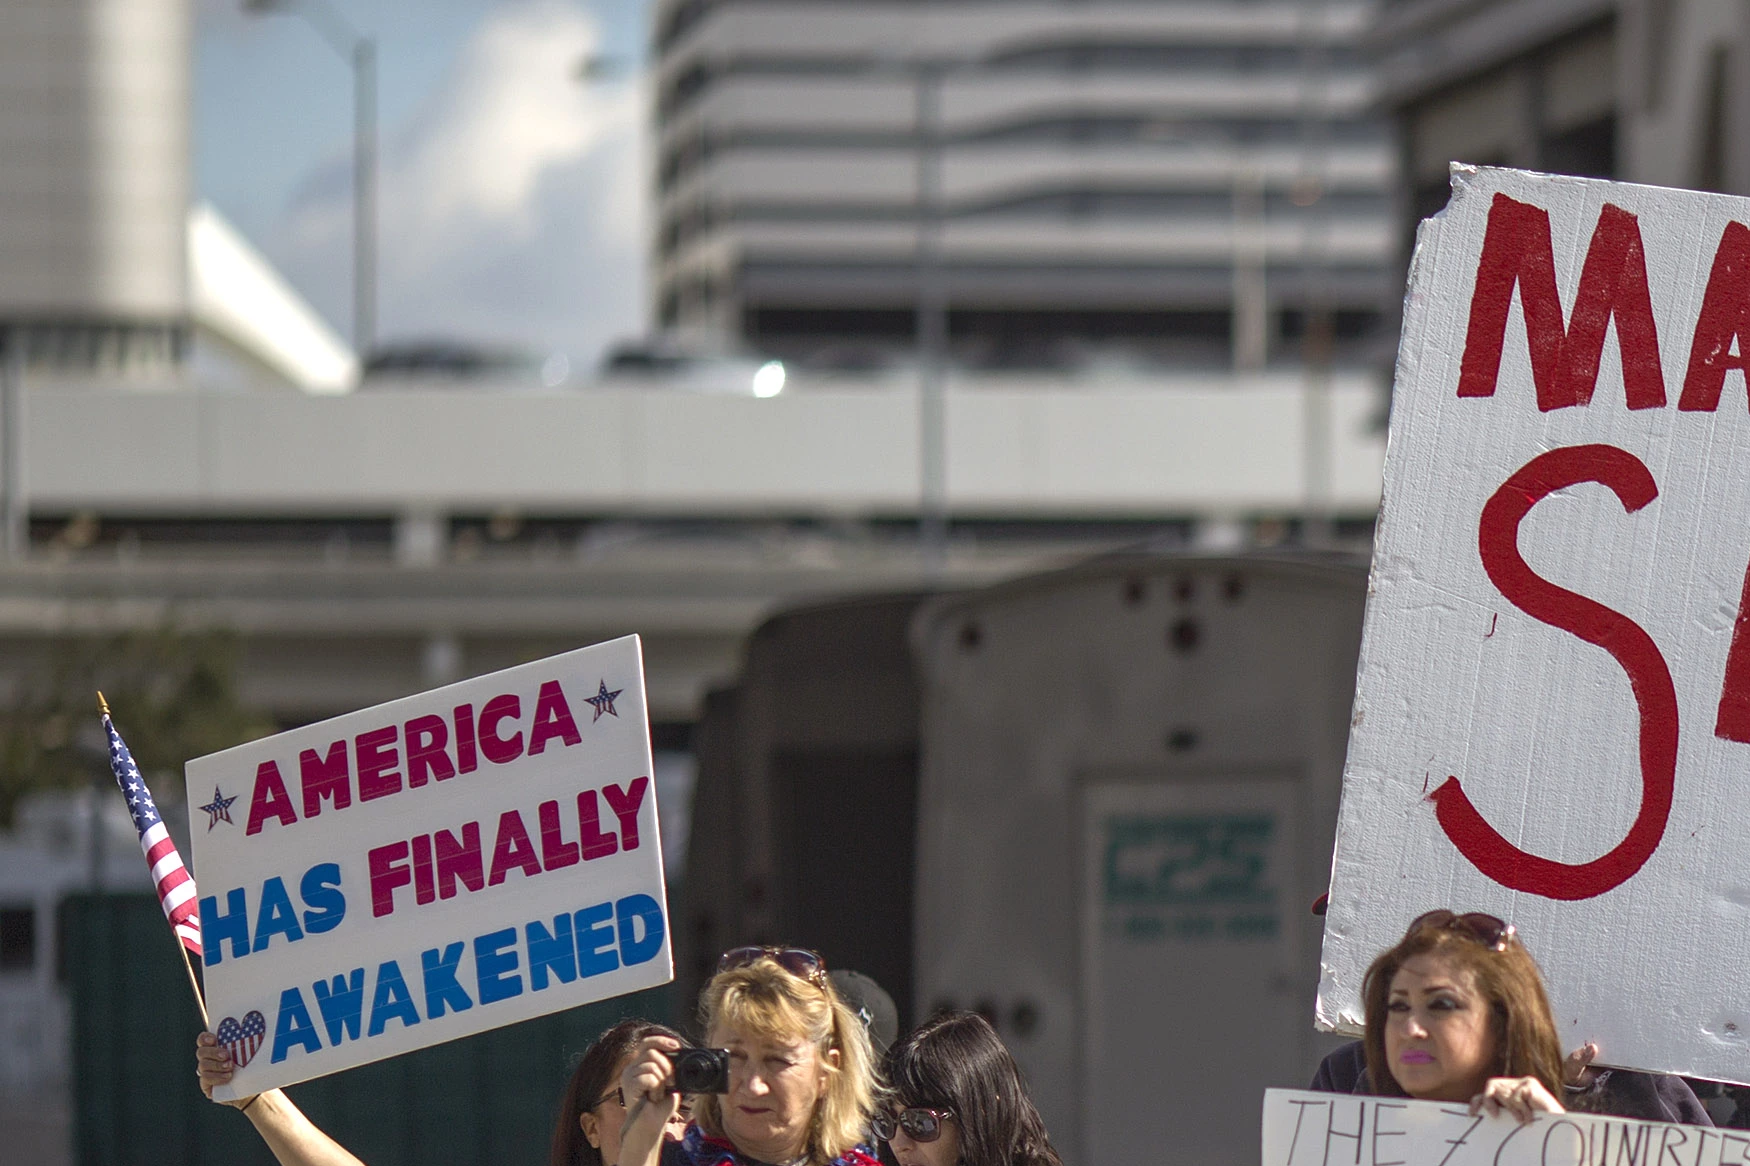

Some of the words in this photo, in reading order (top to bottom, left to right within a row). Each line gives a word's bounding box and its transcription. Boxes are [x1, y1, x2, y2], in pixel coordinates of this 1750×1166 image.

[246, 679, 583, 836] AMERICA
[200, 863, 346, 967] HAS
[368, 776, 650, 918] FINALLY
[271, 893, 665, 1065] AWAKENED
